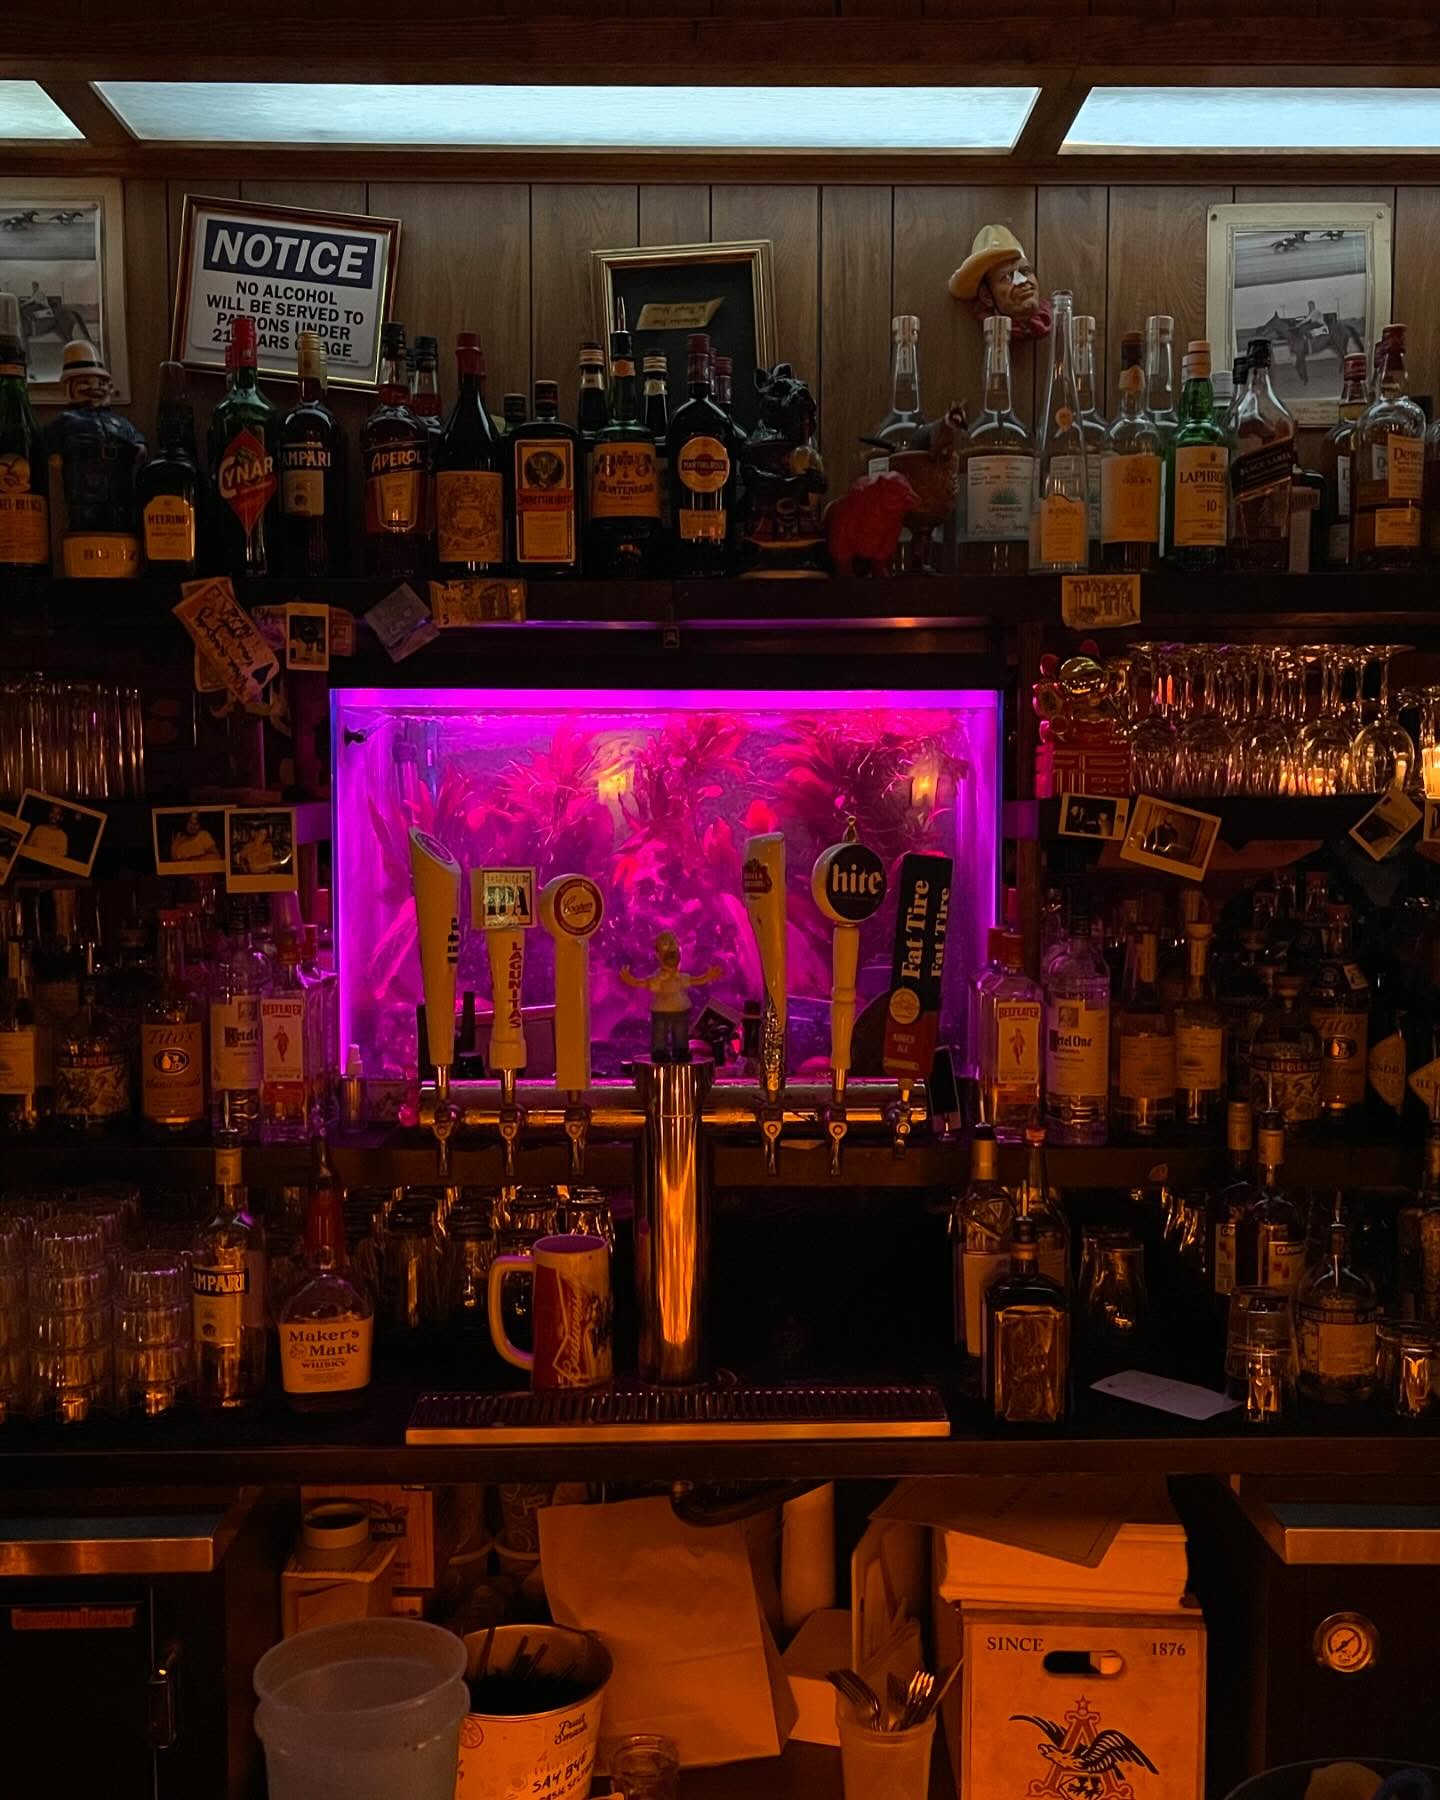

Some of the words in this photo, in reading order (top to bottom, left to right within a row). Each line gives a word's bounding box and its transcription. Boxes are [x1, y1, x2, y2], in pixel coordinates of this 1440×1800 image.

[211, 229, 369, 279] NOTICE
[236, 281, 258, 295] NO
[263, 285, 337, 305] ALCOHOL
[207, 294, 245, 311] WILL
[250, 300, 271, 313] BE
[276, 302, 339, 322] SERVED
[344, 310, 364, 325] TO
[212, 328, 232, 343] 21
[370, 450, 423, 471] APEROL
[218, 455, 274, 499] CYNAR
[1180, 471, 1227, 484] LAPHRO
[832, 863, 883, 895] hite
[487, 885, 530, 916] IPA
[906, 879, 930, 934] Tire
[934, 887, 951, 937] Tire
[901, 939, 924, 980] Fat
[930, 944, 945, 978] Fat
[508, 941, 522, 1029] LAGUNITAS
[192, 1271, 245, 1293] AMPARI
[290, 1328, 360, 1342] Maker's
[310, 1343, 359, 1356] Mark
[302, 1359, 345, 1369] WHISKY
[987, 1637, 1044, 1652] SINCE
[1151, 1642, 1186, 1656] 1876
